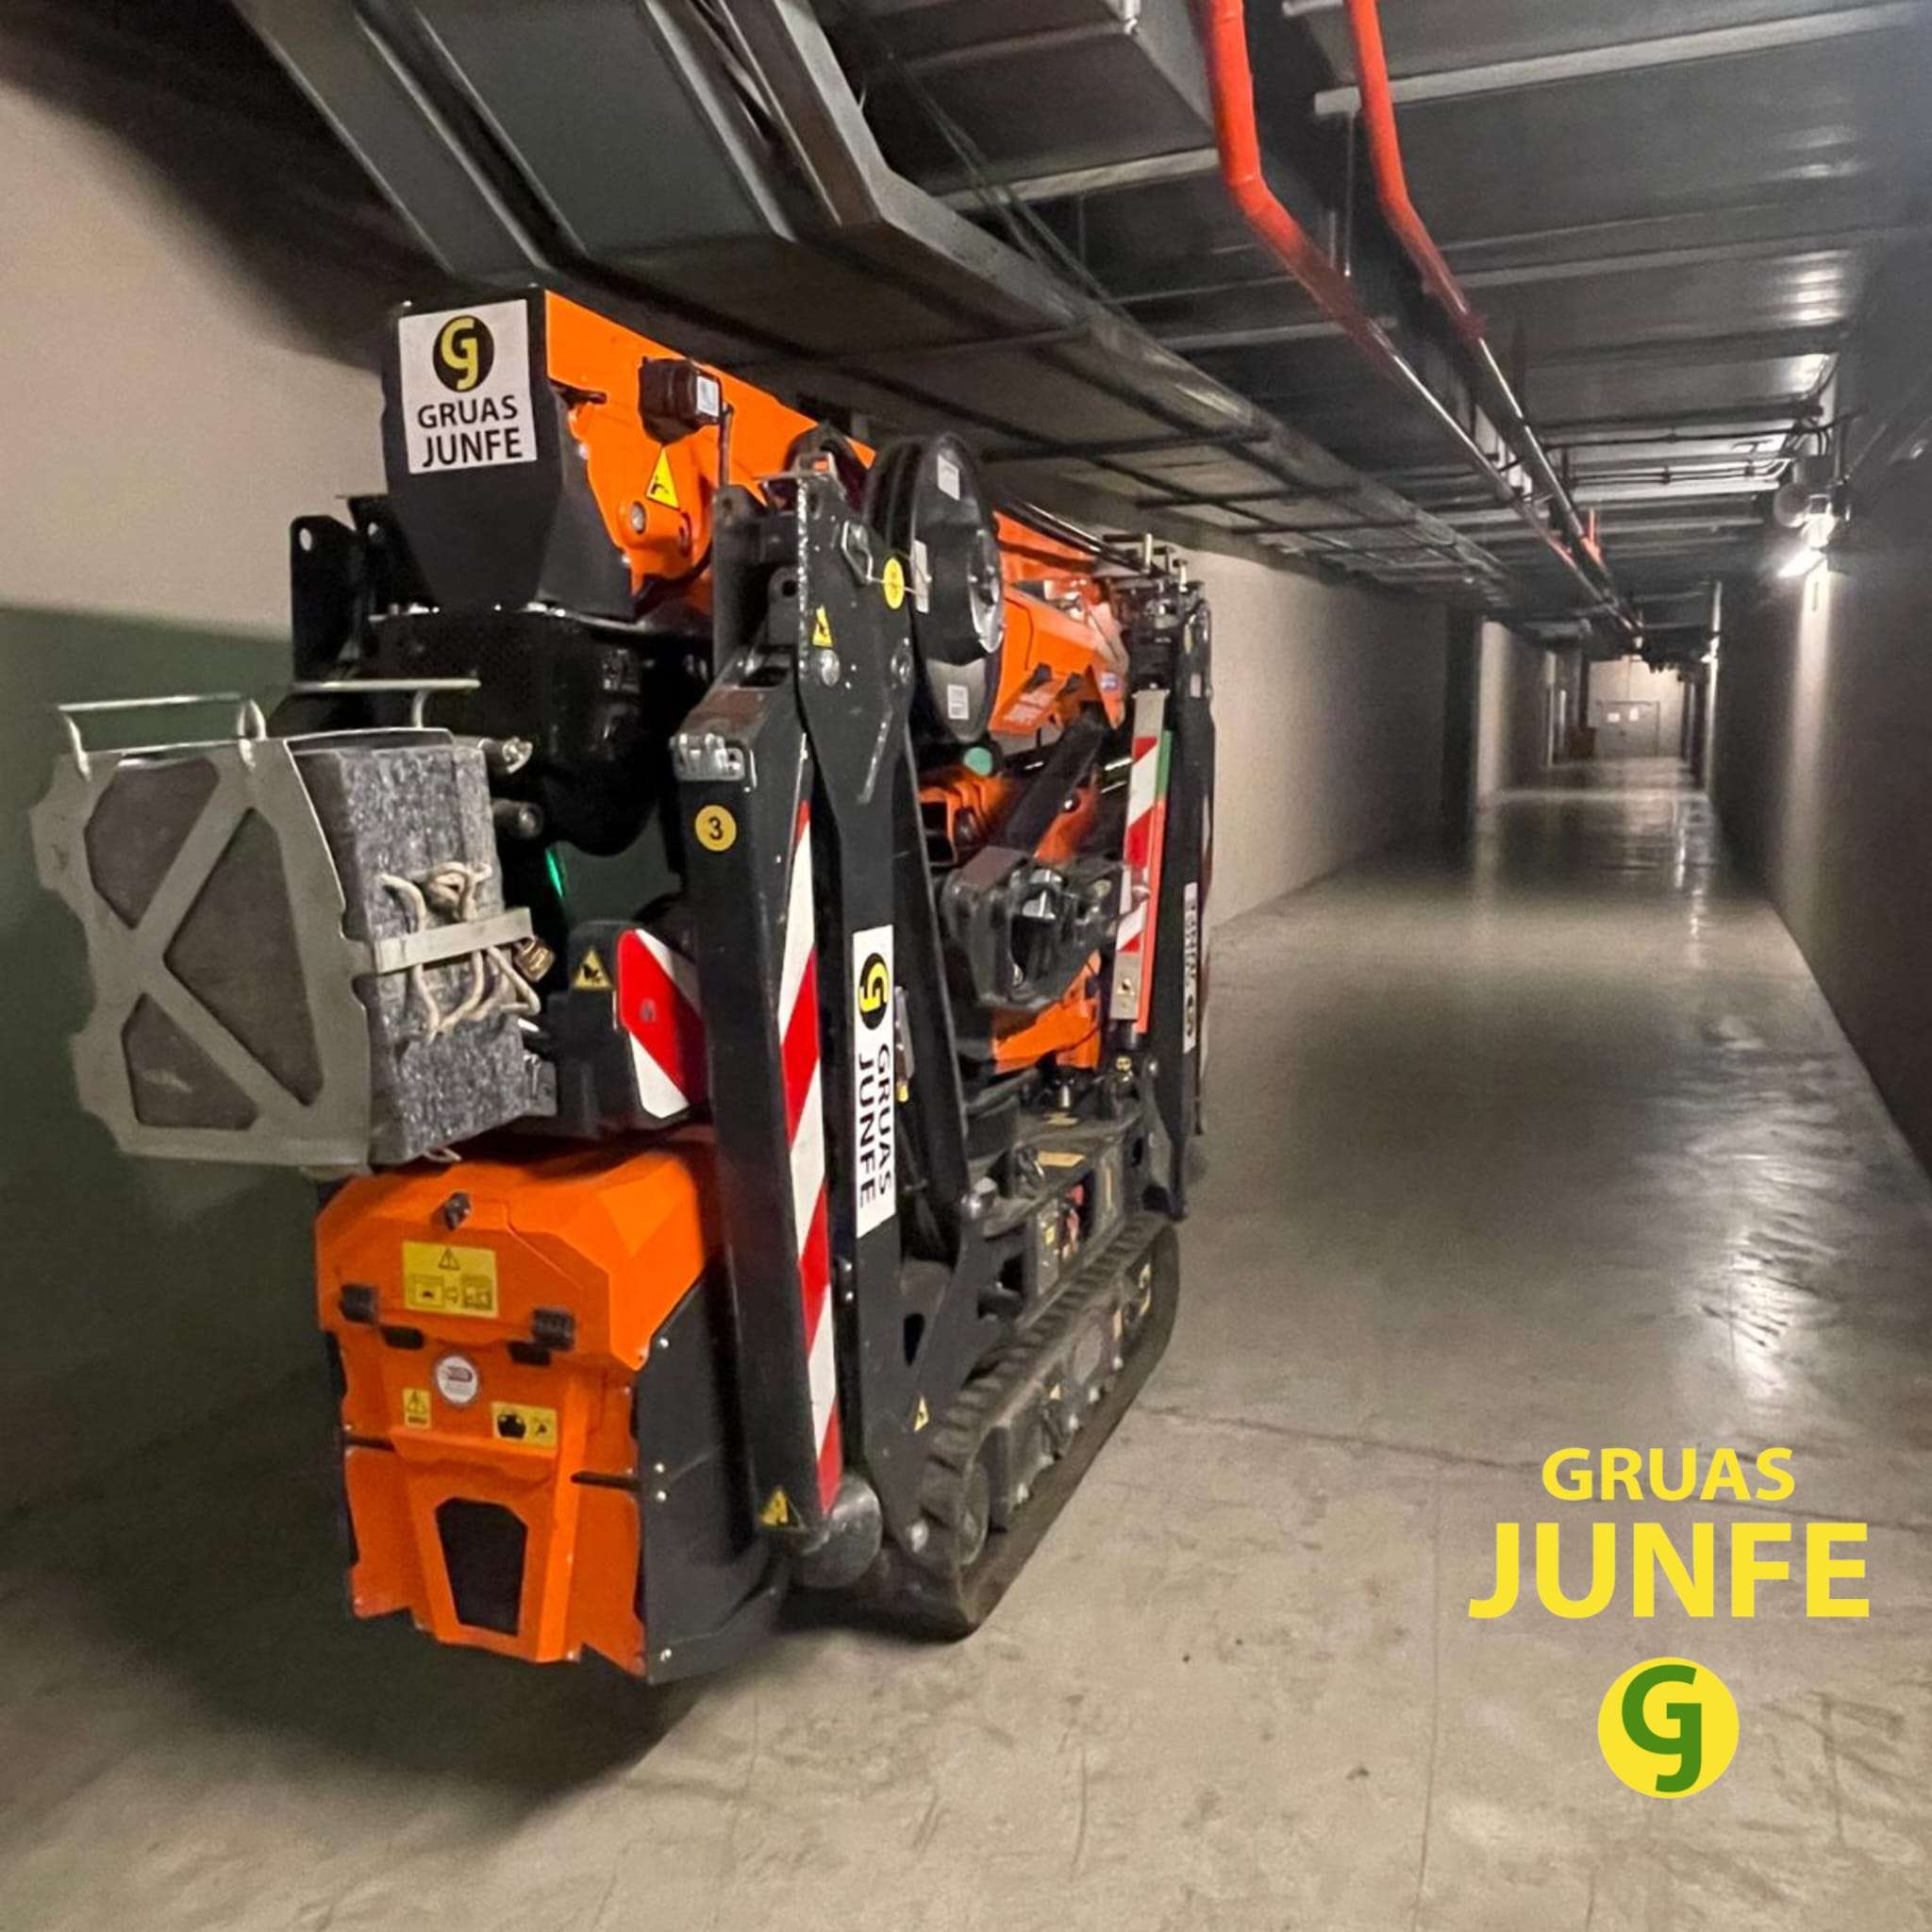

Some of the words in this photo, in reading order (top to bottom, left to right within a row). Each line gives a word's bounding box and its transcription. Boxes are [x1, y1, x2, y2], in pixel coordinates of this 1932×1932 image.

[417, 395, 518, 429] GRUAS
[422, 427, 523, 468] JUNFE
[709, 816, 724, 841] 3
[858, 1053, 877, 1208] JUNFE
[877, 1043, 891, 1196] GRUAS
